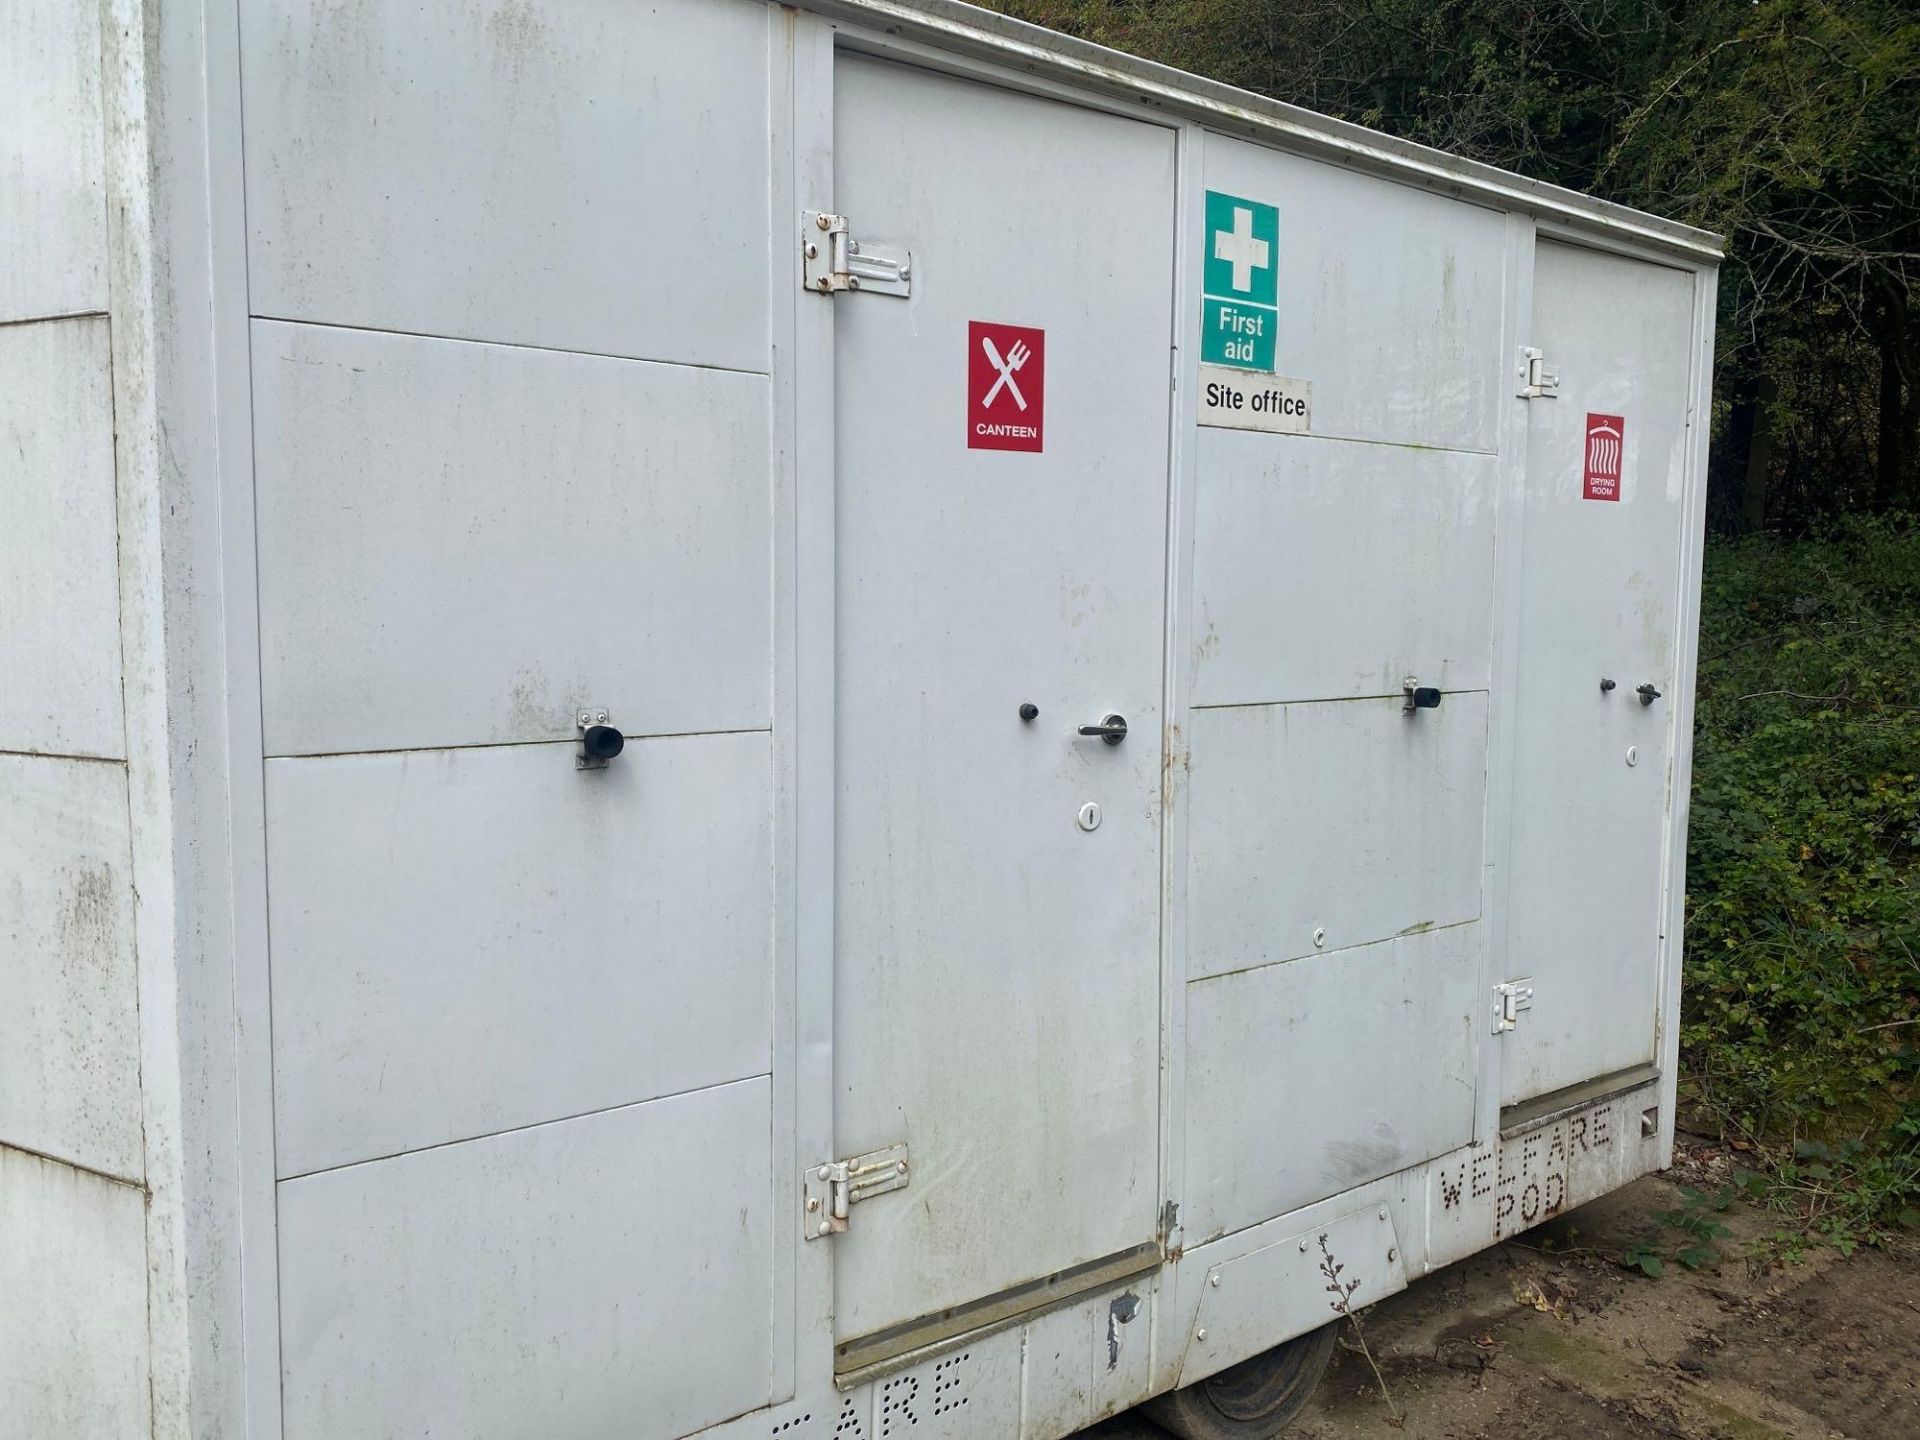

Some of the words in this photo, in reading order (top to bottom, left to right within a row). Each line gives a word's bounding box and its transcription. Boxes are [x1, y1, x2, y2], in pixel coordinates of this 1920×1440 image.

[1219, 306, 1264, 336] First
[1225, 338, 1255, 361] aid
[1206, 383, 1244, 410] Site
[1251, 389, 1305, 416] office
[976, 423, 1037, 438] CANTEEN
[1590, 477, 1616, 487] DRYING
[1591, 487, 1613, 495] ROOM
[1441, 1107, 1612, 1210] WELFARE
[1495, 1172, 1564, 1237] POD
